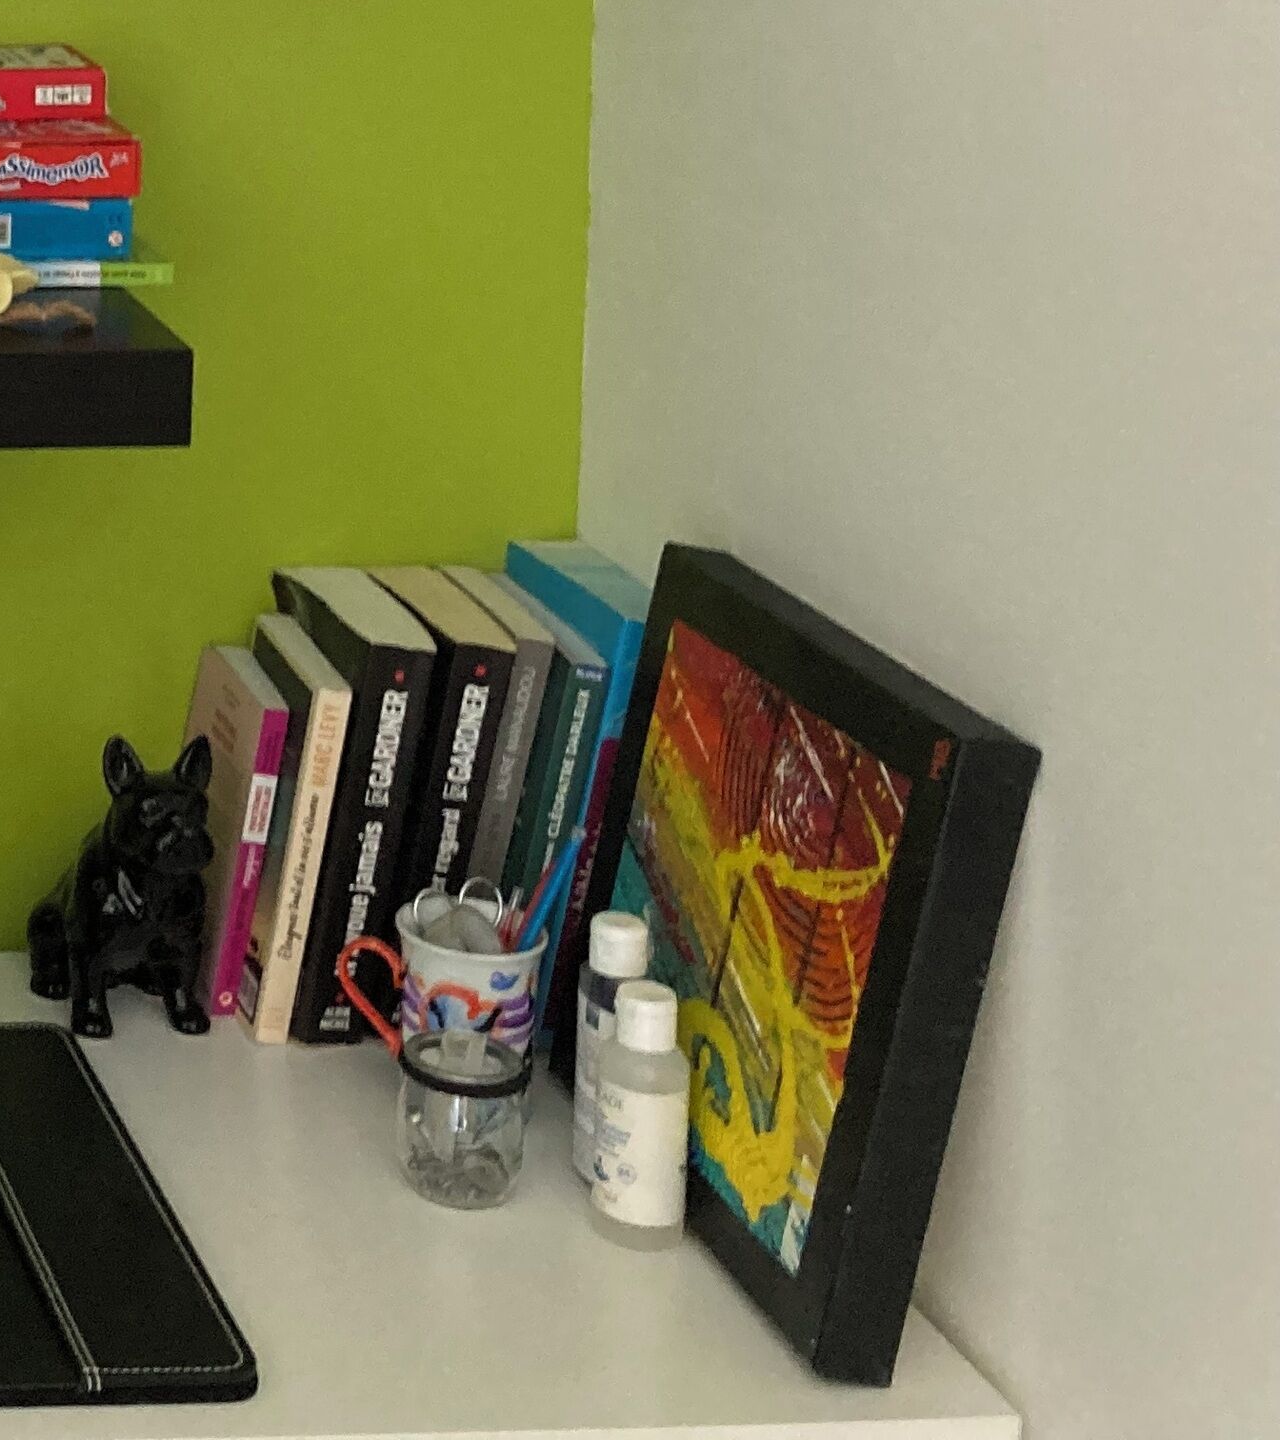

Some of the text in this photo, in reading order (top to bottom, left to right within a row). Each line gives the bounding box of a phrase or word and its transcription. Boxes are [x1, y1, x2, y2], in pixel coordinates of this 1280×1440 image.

[309, 702, 340, 788] MARC LEVY
[368, 689, 409, 790] GARDNER
[447, 683, 490, 783] GARDNER
